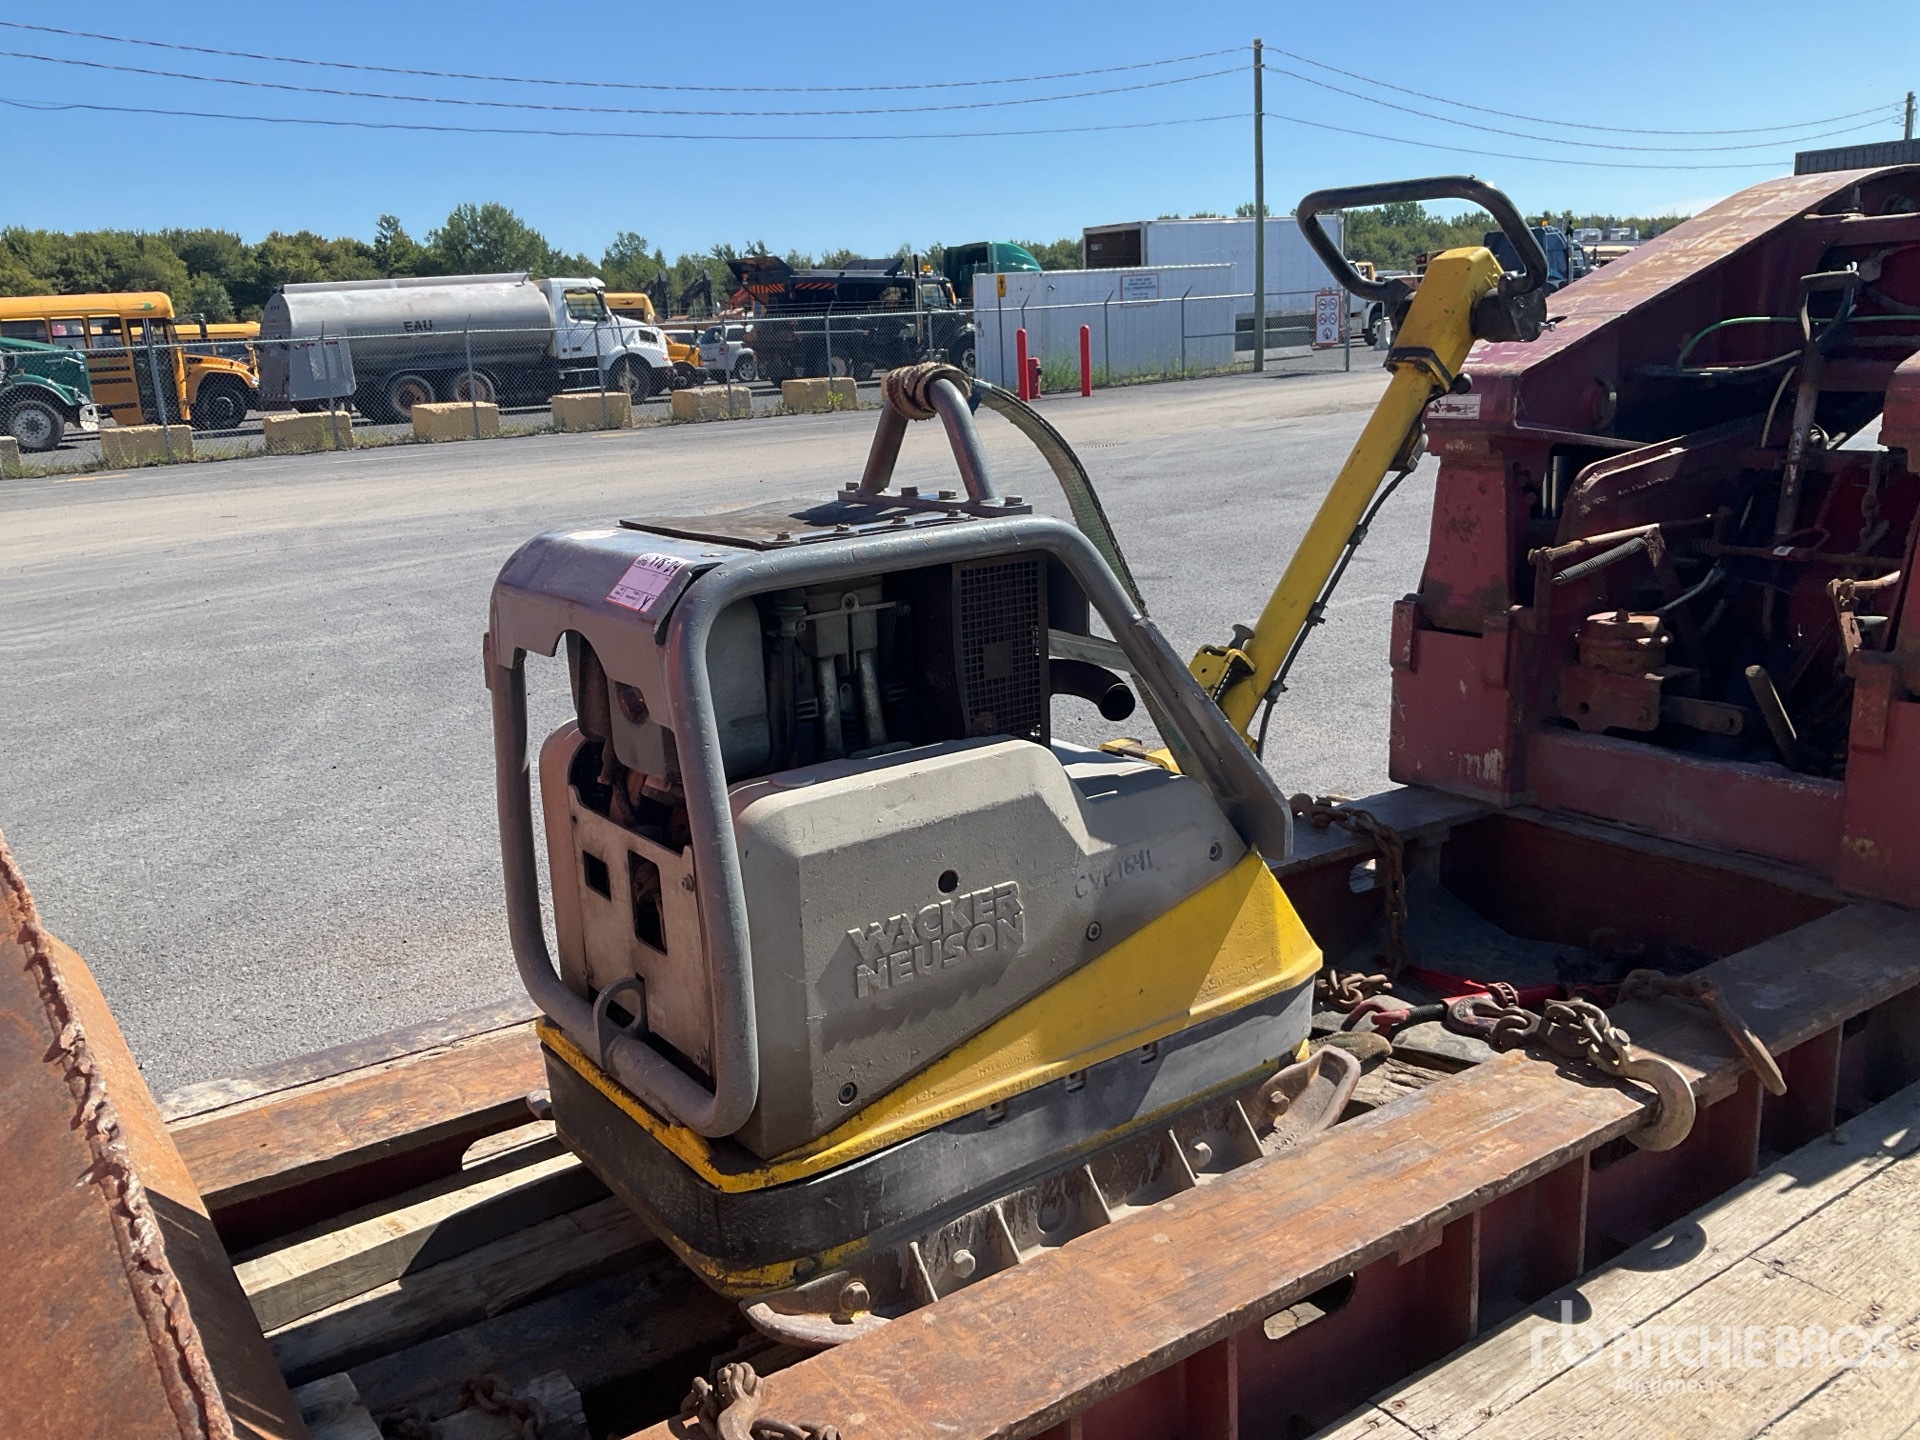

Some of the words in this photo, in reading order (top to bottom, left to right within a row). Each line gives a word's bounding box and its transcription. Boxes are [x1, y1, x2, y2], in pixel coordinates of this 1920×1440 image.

[403, 319, 433, 333] EAU
[846, 880, 1024, 960] WACKER
[856, 911, 1026, 998] NEUSON
